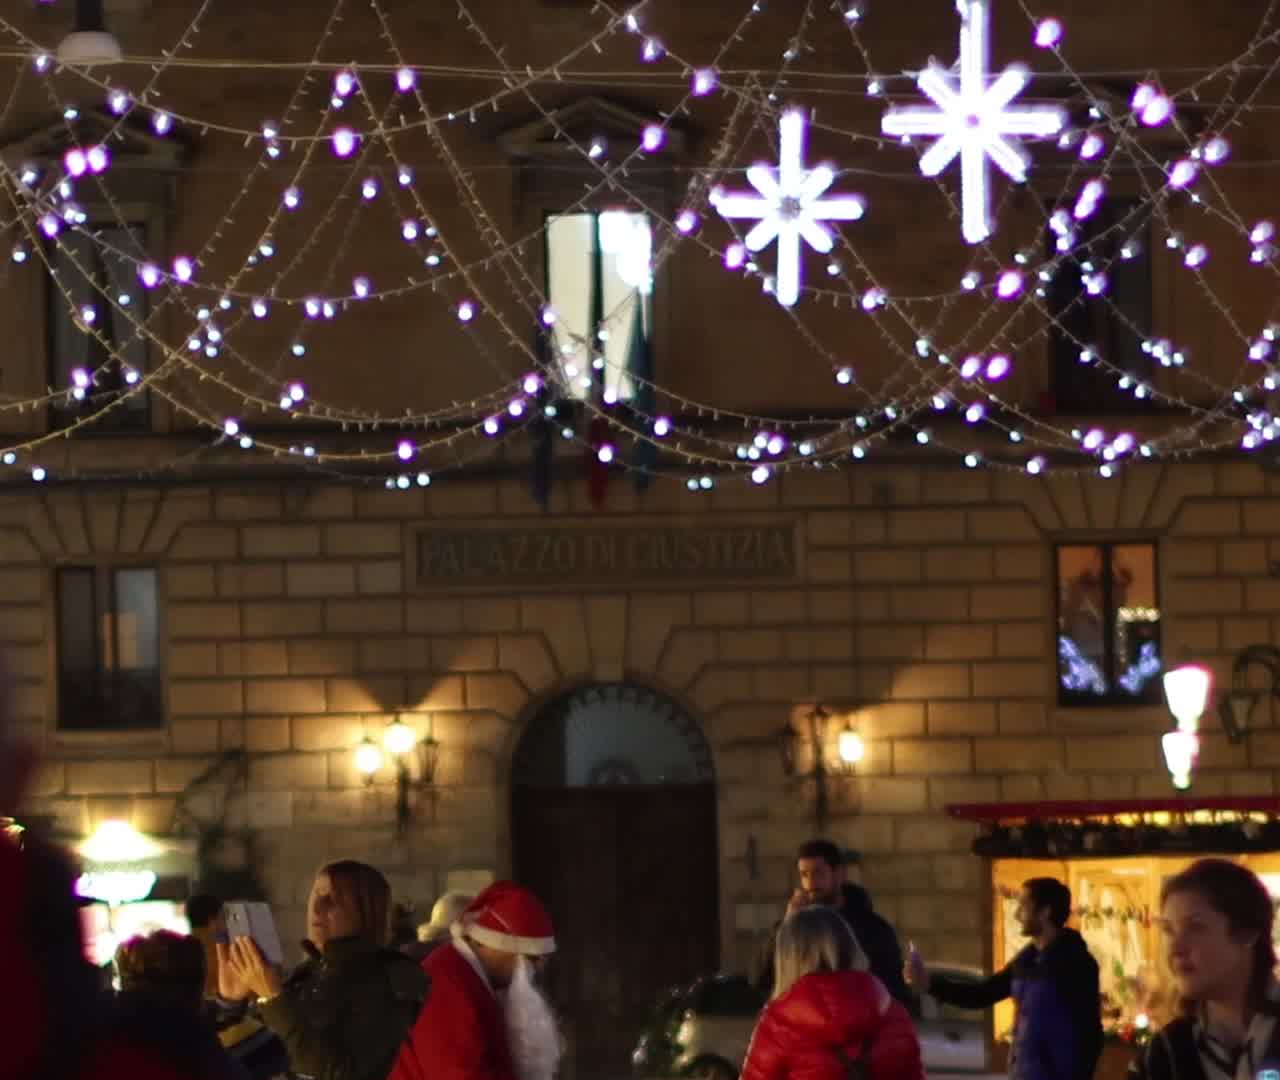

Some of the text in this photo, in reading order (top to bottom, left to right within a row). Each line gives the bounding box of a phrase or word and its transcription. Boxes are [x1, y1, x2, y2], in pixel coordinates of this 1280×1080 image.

[422, 529, 793, 577] PALAZZO DI GIUSTIZIA
